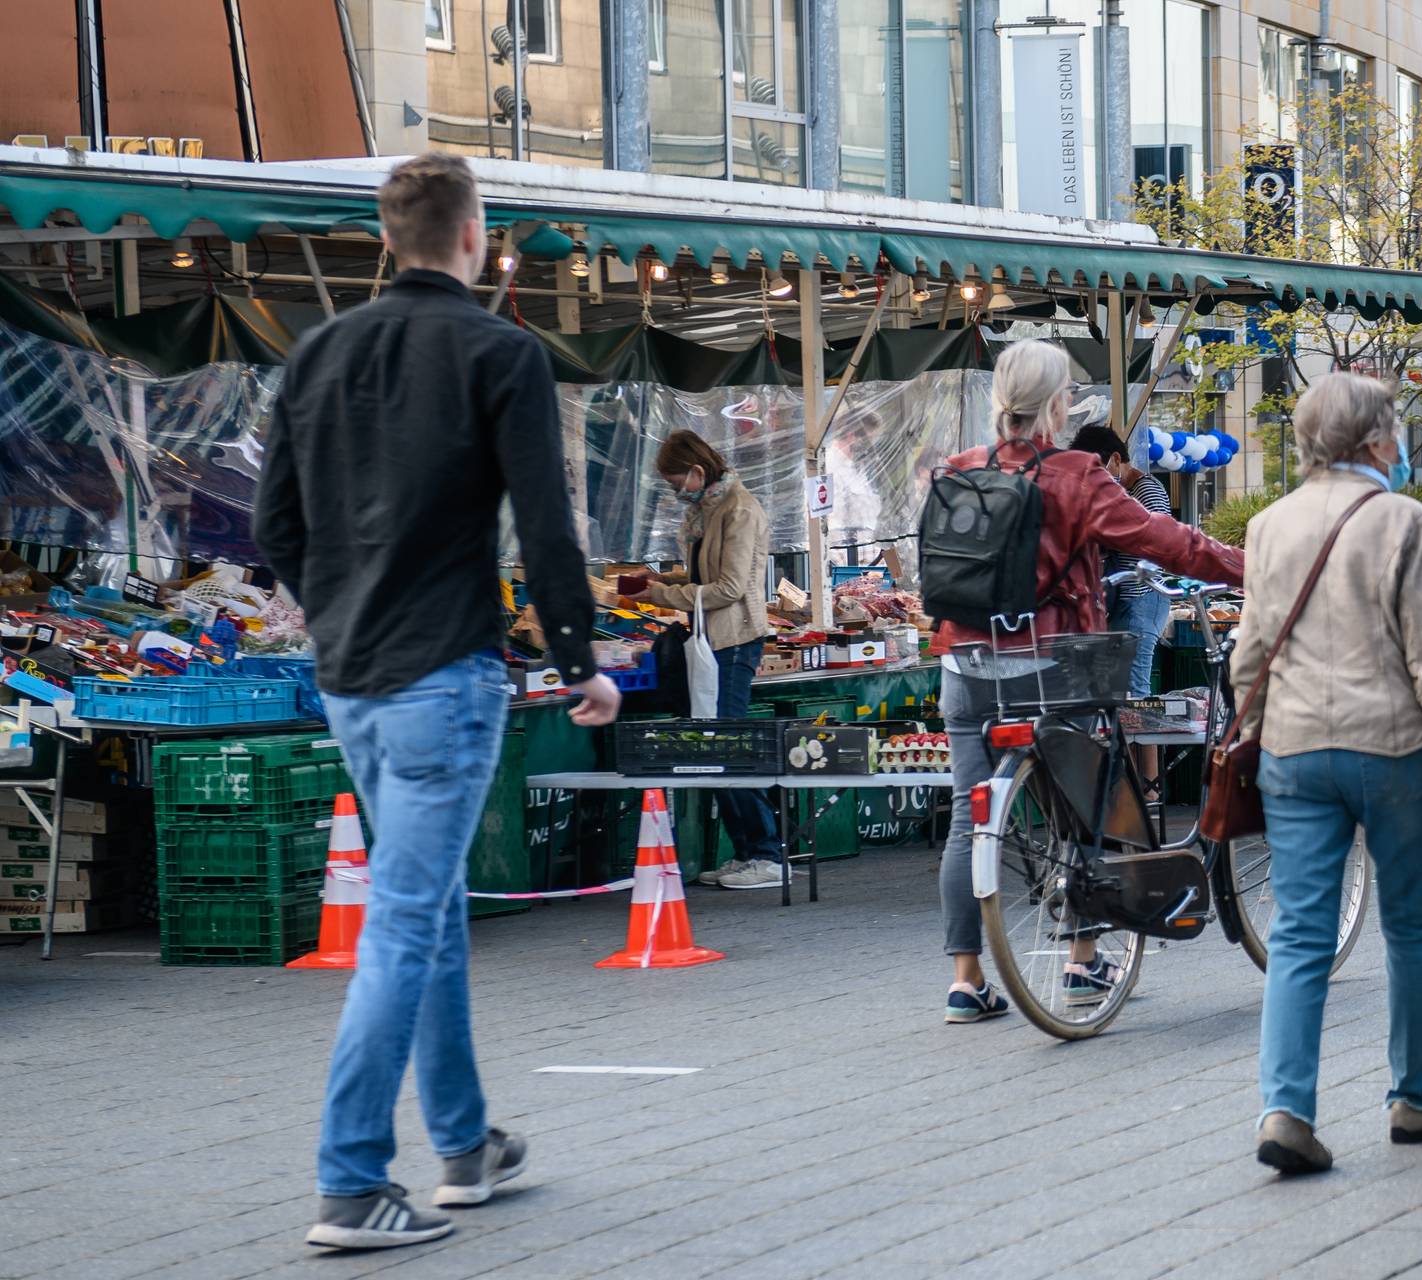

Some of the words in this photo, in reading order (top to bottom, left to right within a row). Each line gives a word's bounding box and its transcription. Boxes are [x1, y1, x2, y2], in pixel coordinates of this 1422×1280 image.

[1057, 47, 1073, 100] SCHÖN!
[1060, 104, 1074, 125] IST
[1062, 129, 1077, 172] LEBEN
[1063, 175, 1077, 204] DAS
